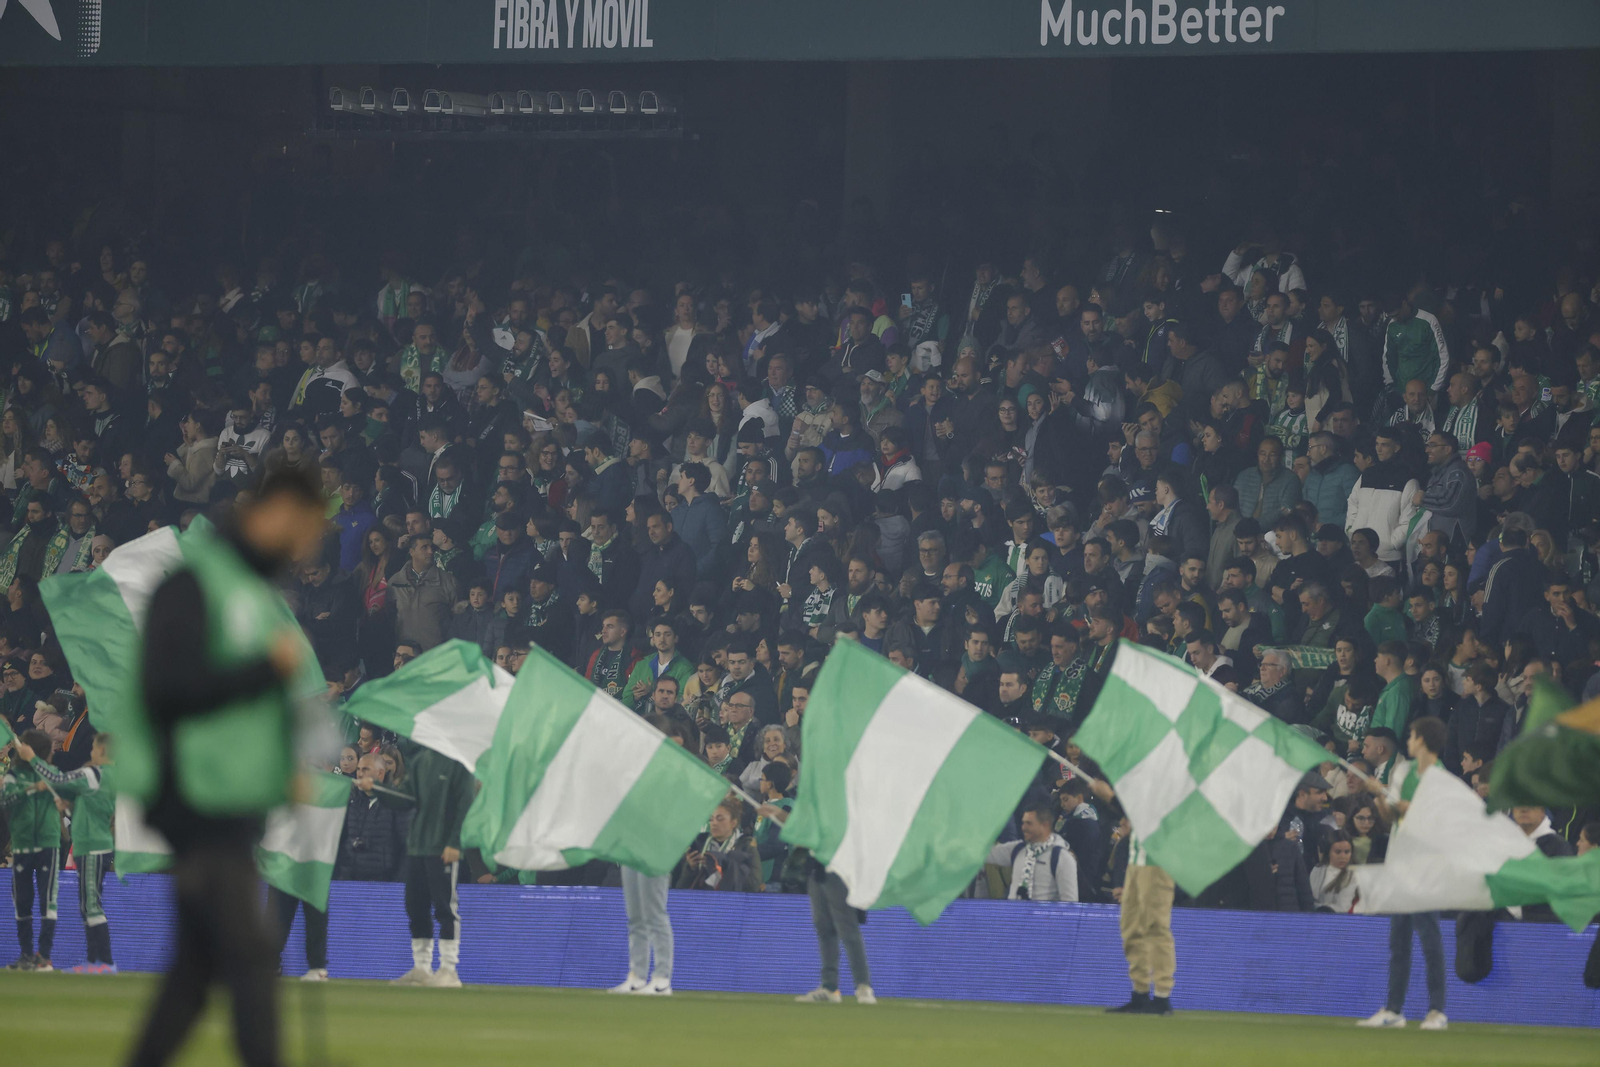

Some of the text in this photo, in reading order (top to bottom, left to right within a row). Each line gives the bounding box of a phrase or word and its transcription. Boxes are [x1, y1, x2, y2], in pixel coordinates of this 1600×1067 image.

[494, 0, 559, 49] FIBRA
[565, 0, 579, 48] Y
[1040, 0, 1286, 46] MuchBetter
